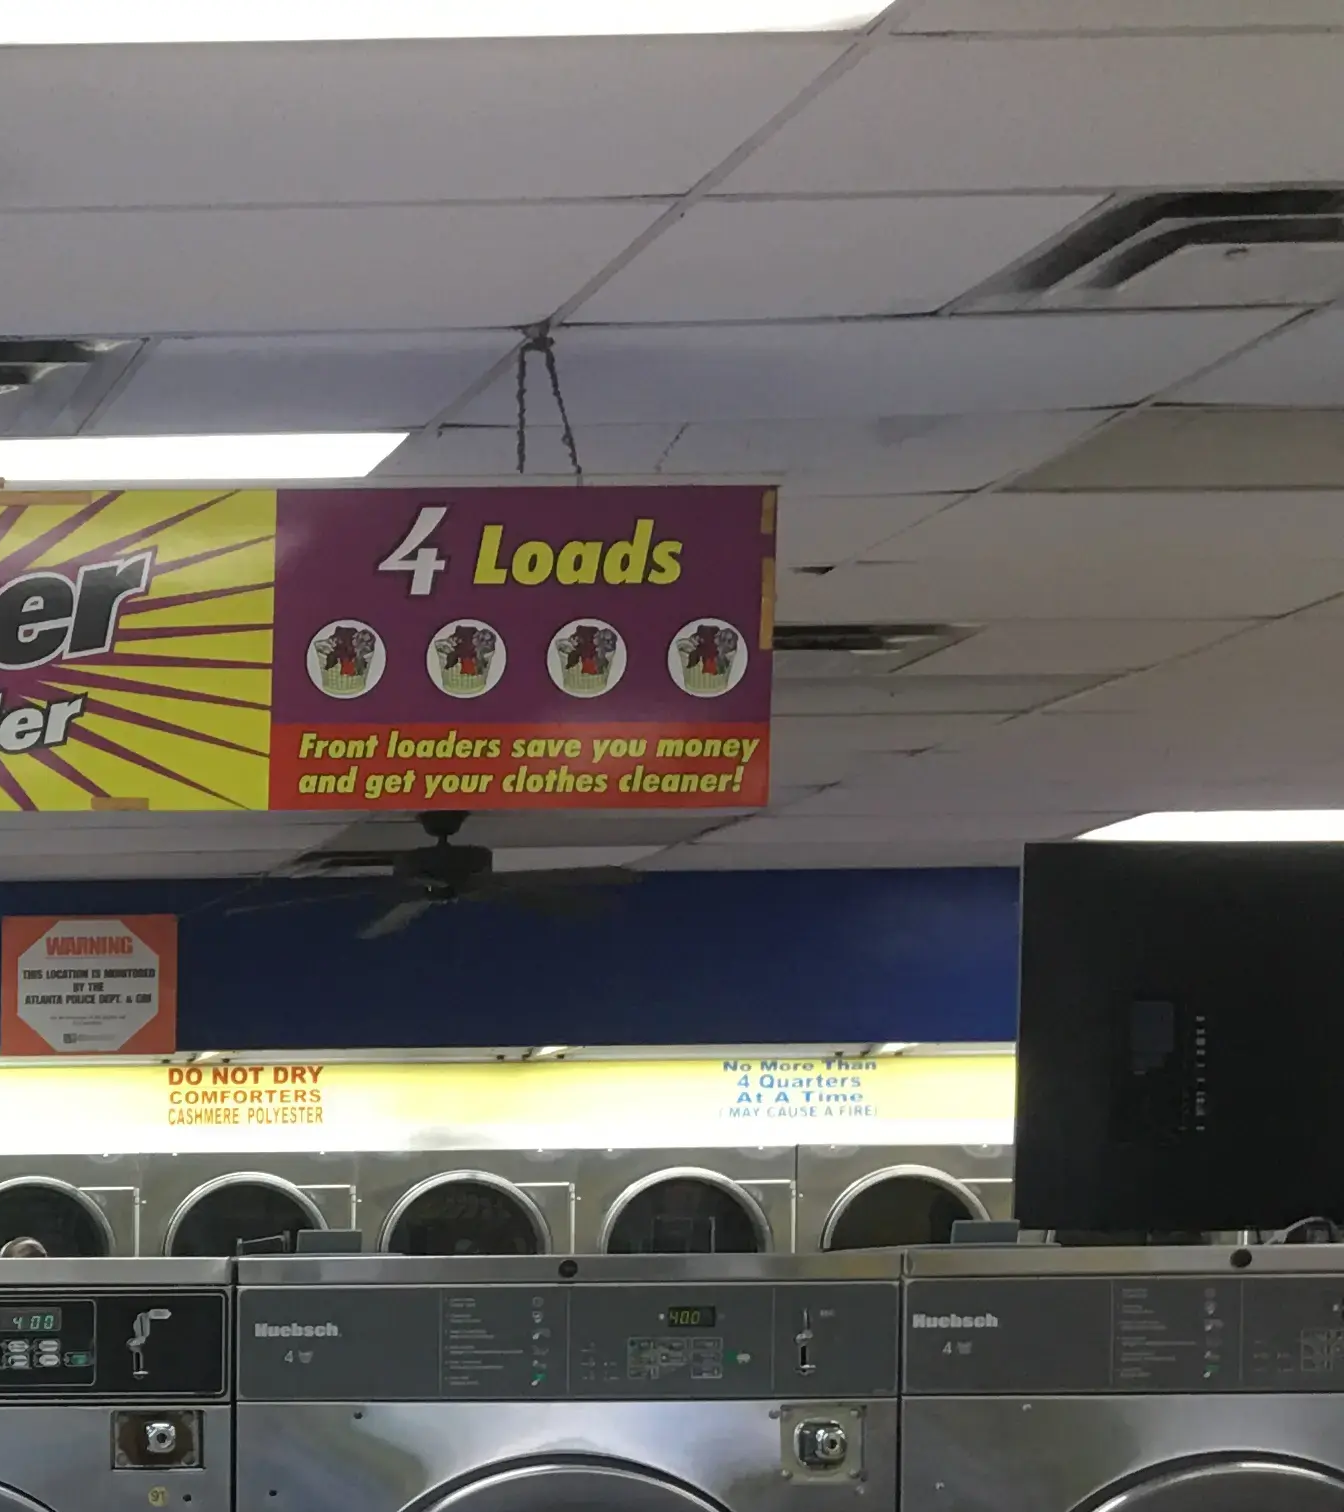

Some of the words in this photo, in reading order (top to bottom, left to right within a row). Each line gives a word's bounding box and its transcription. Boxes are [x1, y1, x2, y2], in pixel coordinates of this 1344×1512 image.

[379, 507, 446, 595] 4
[472, 520, 683, 586] Loads
[299, 732, 377, 759] Front
[387, 731, 500, 758] loaders
[511, 736, 581, 758] save
[592, 737, 647, 762] you
[656, 737, 759, 762] money
[299, 767, 357, 794] and
[365, 771, 416, 799] get
[424, 771, 494, 798] your
[502, 766, 608, 793] clothes
[619, 766, 744, 793] cleaner!
[45, 936, 133, 956] WARNING
[46, 969, 88, 980] LOCATION
[88, 982, 104, 992] THE
[25, 994, 63, 1005] ATLANTA
[66, 994, 95, 1004] POLICE
[722, 1061, 752, 1072] No
[760, 1061, 814, 1072] More
[822, 1060, 877, 1071] Than
[168, 1067, 203, 1086] DO
[212, 1066, 265, 1085] NOT
[273, 1066, 324, 1084] DRY
[737, 1075, 750, 1088] 4
[759, 1075, 861, 1089] Quarters
[169, 1089, 322, 1105] COMFORTERS
[736, 1091, 762, 1103] At
[774, 1091, 790, 1103] A
[802, 1090, 863, 1103] Time
[168, 1107, 239, 1125] CASHMERE
[247, 1106, 323, 1124] POLYESTER
[766, 1106, 817, 1118] CAUSE
[824, 1106, 834, 1117] A
[912, 1314, 999, 1329] Huebsch
[254, 1323, 340, 1338] Huebsch
[942, 1342, 952, 1354] 4
[284, 1352, 294, 1364] 4
